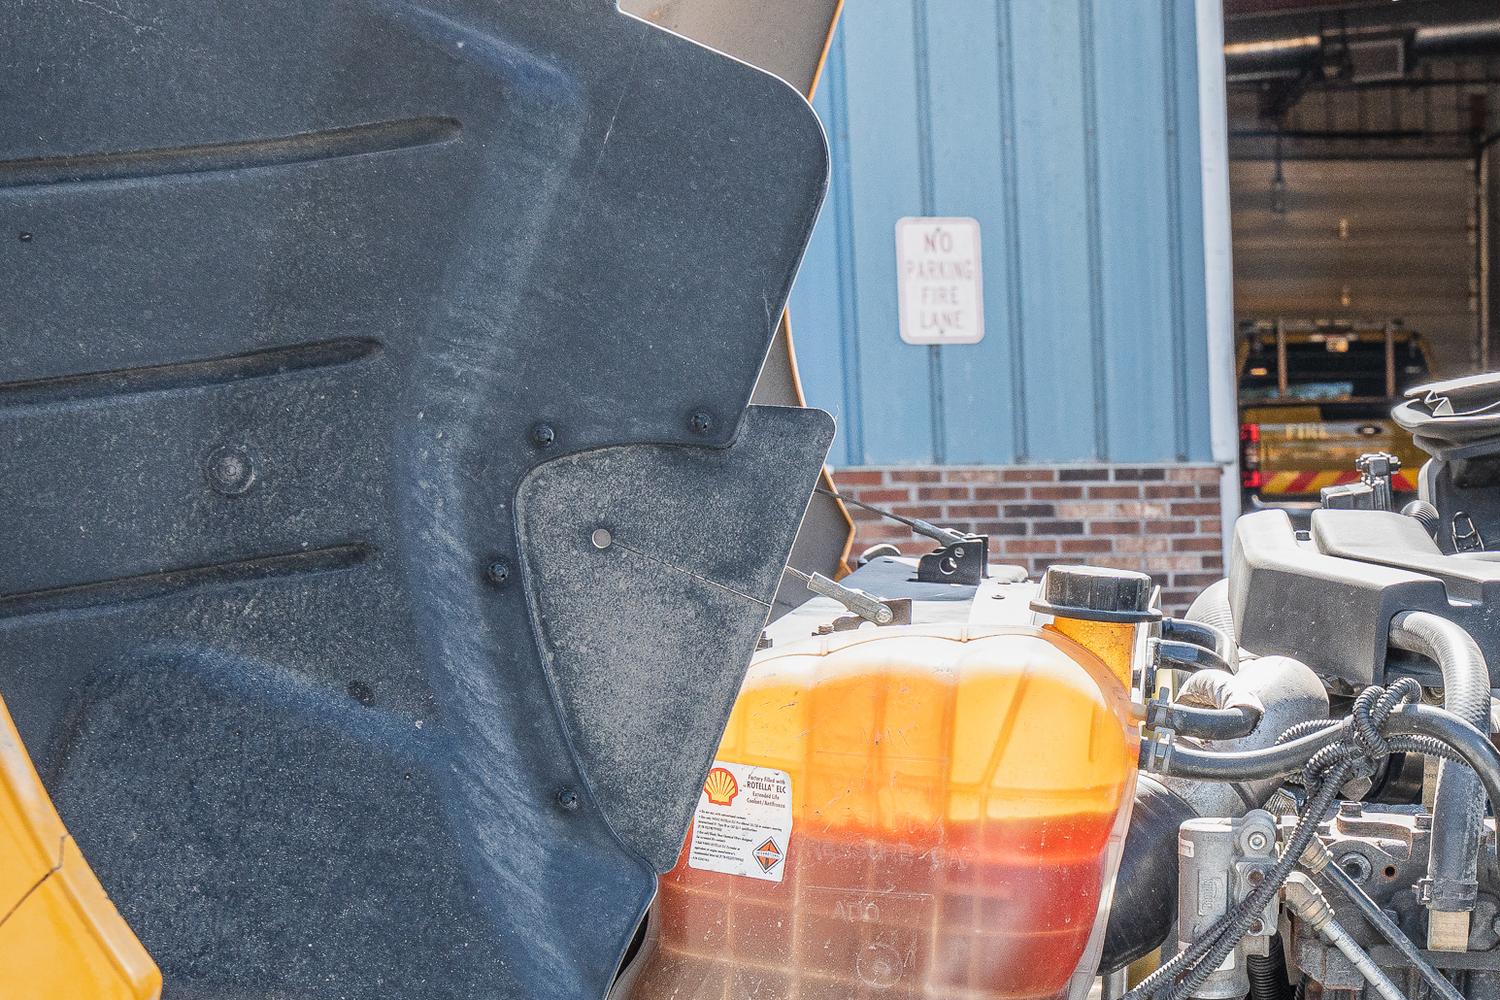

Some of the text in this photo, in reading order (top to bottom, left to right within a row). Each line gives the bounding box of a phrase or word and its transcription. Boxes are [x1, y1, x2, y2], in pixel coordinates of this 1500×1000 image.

[923, 232, 953, 253] NO
[905, 260, 974, 280] PARKING
[921, 286, 959, 305] FIRE
[919, 310, 964, 330] LANE
[776, 785, 787, 794] ELC
